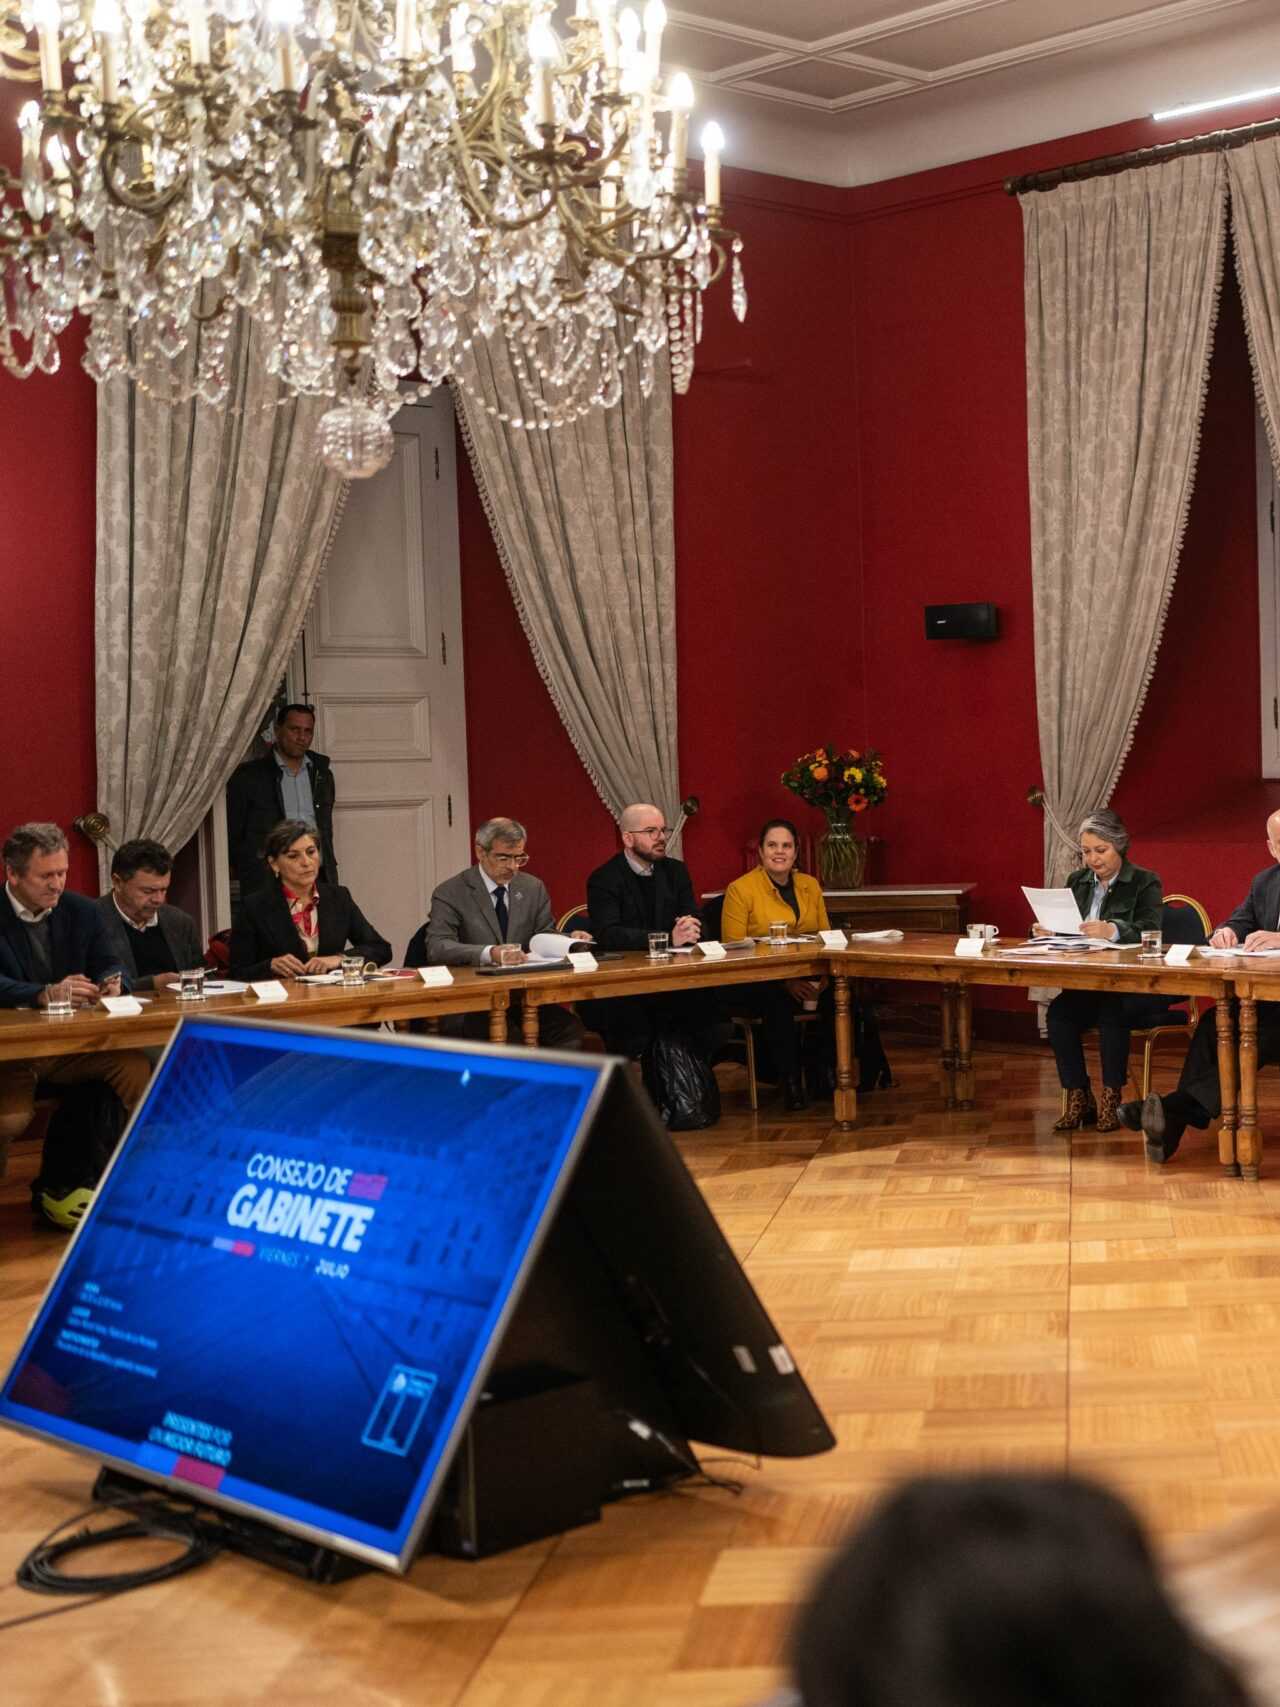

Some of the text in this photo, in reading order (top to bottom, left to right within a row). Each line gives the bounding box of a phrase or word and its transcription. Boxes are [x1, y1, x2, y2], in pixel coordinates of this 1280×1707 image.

[247, 1153, 353, 1195] CONSEJO DE
[227, 1183, 375, 1253] GABINETE
[315, 1258, 350, 1279] JULIO
